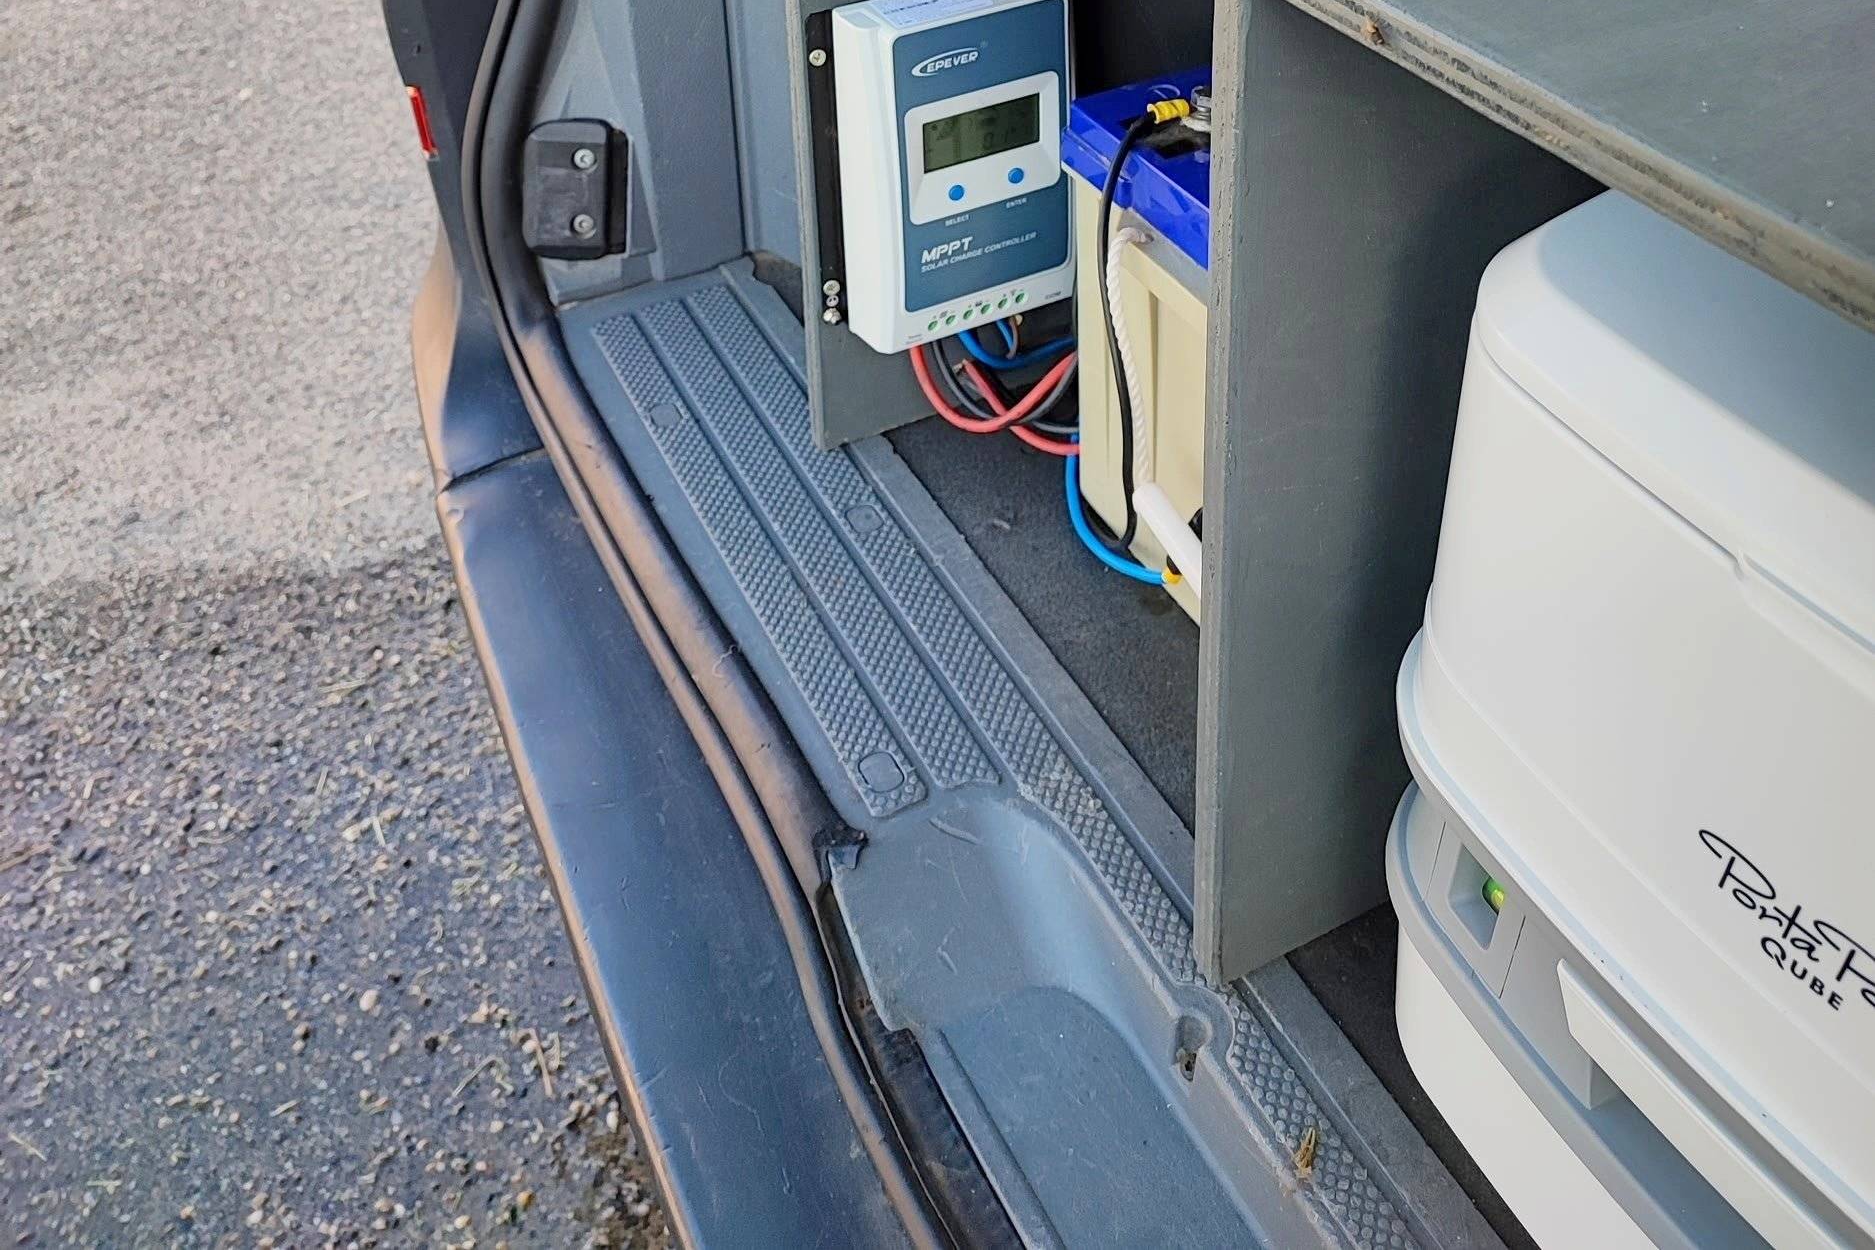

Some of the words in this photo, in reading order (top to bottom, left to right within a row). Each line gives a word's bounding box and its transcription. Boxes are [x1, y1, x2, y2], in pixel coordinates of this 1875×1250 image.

[926, 51, 979, 74] EPEVER
[945, 214, 970, 227] SELECT
[921, 236, 974, 264] MPPT
[921, 258, 949, 273] SOLAR
[950, 248, 984, 264] CHARGE
[984, 231, 1038, 254] CONTROLLER
[1760, 937, 1844, 1011] QUBE
